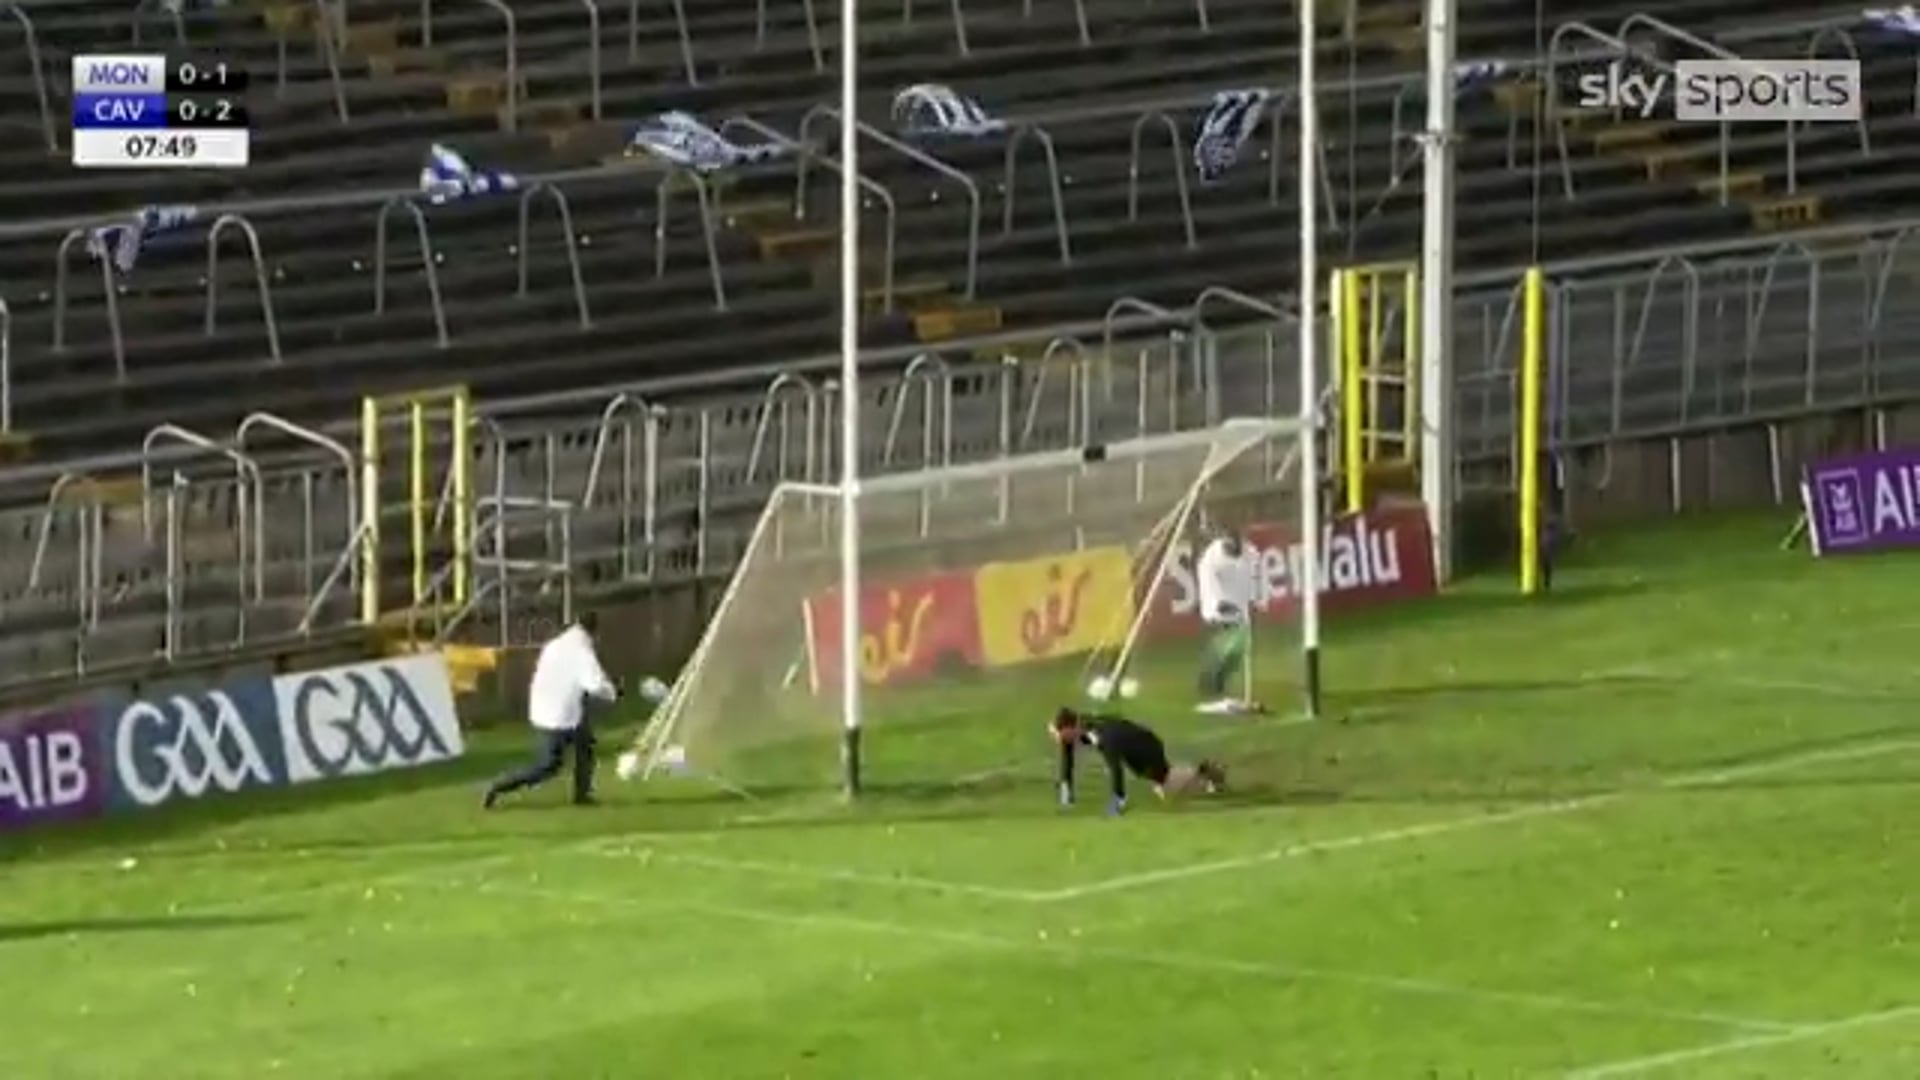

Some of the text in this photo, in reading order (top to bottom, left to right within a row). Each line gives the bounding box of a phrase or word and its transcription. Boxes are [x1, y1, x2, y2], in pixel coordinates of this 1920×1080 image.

[860, 589, 934, 684] eir
[115, 690, 272, 805] GAA
[295, 666, 449, 775] GAA
